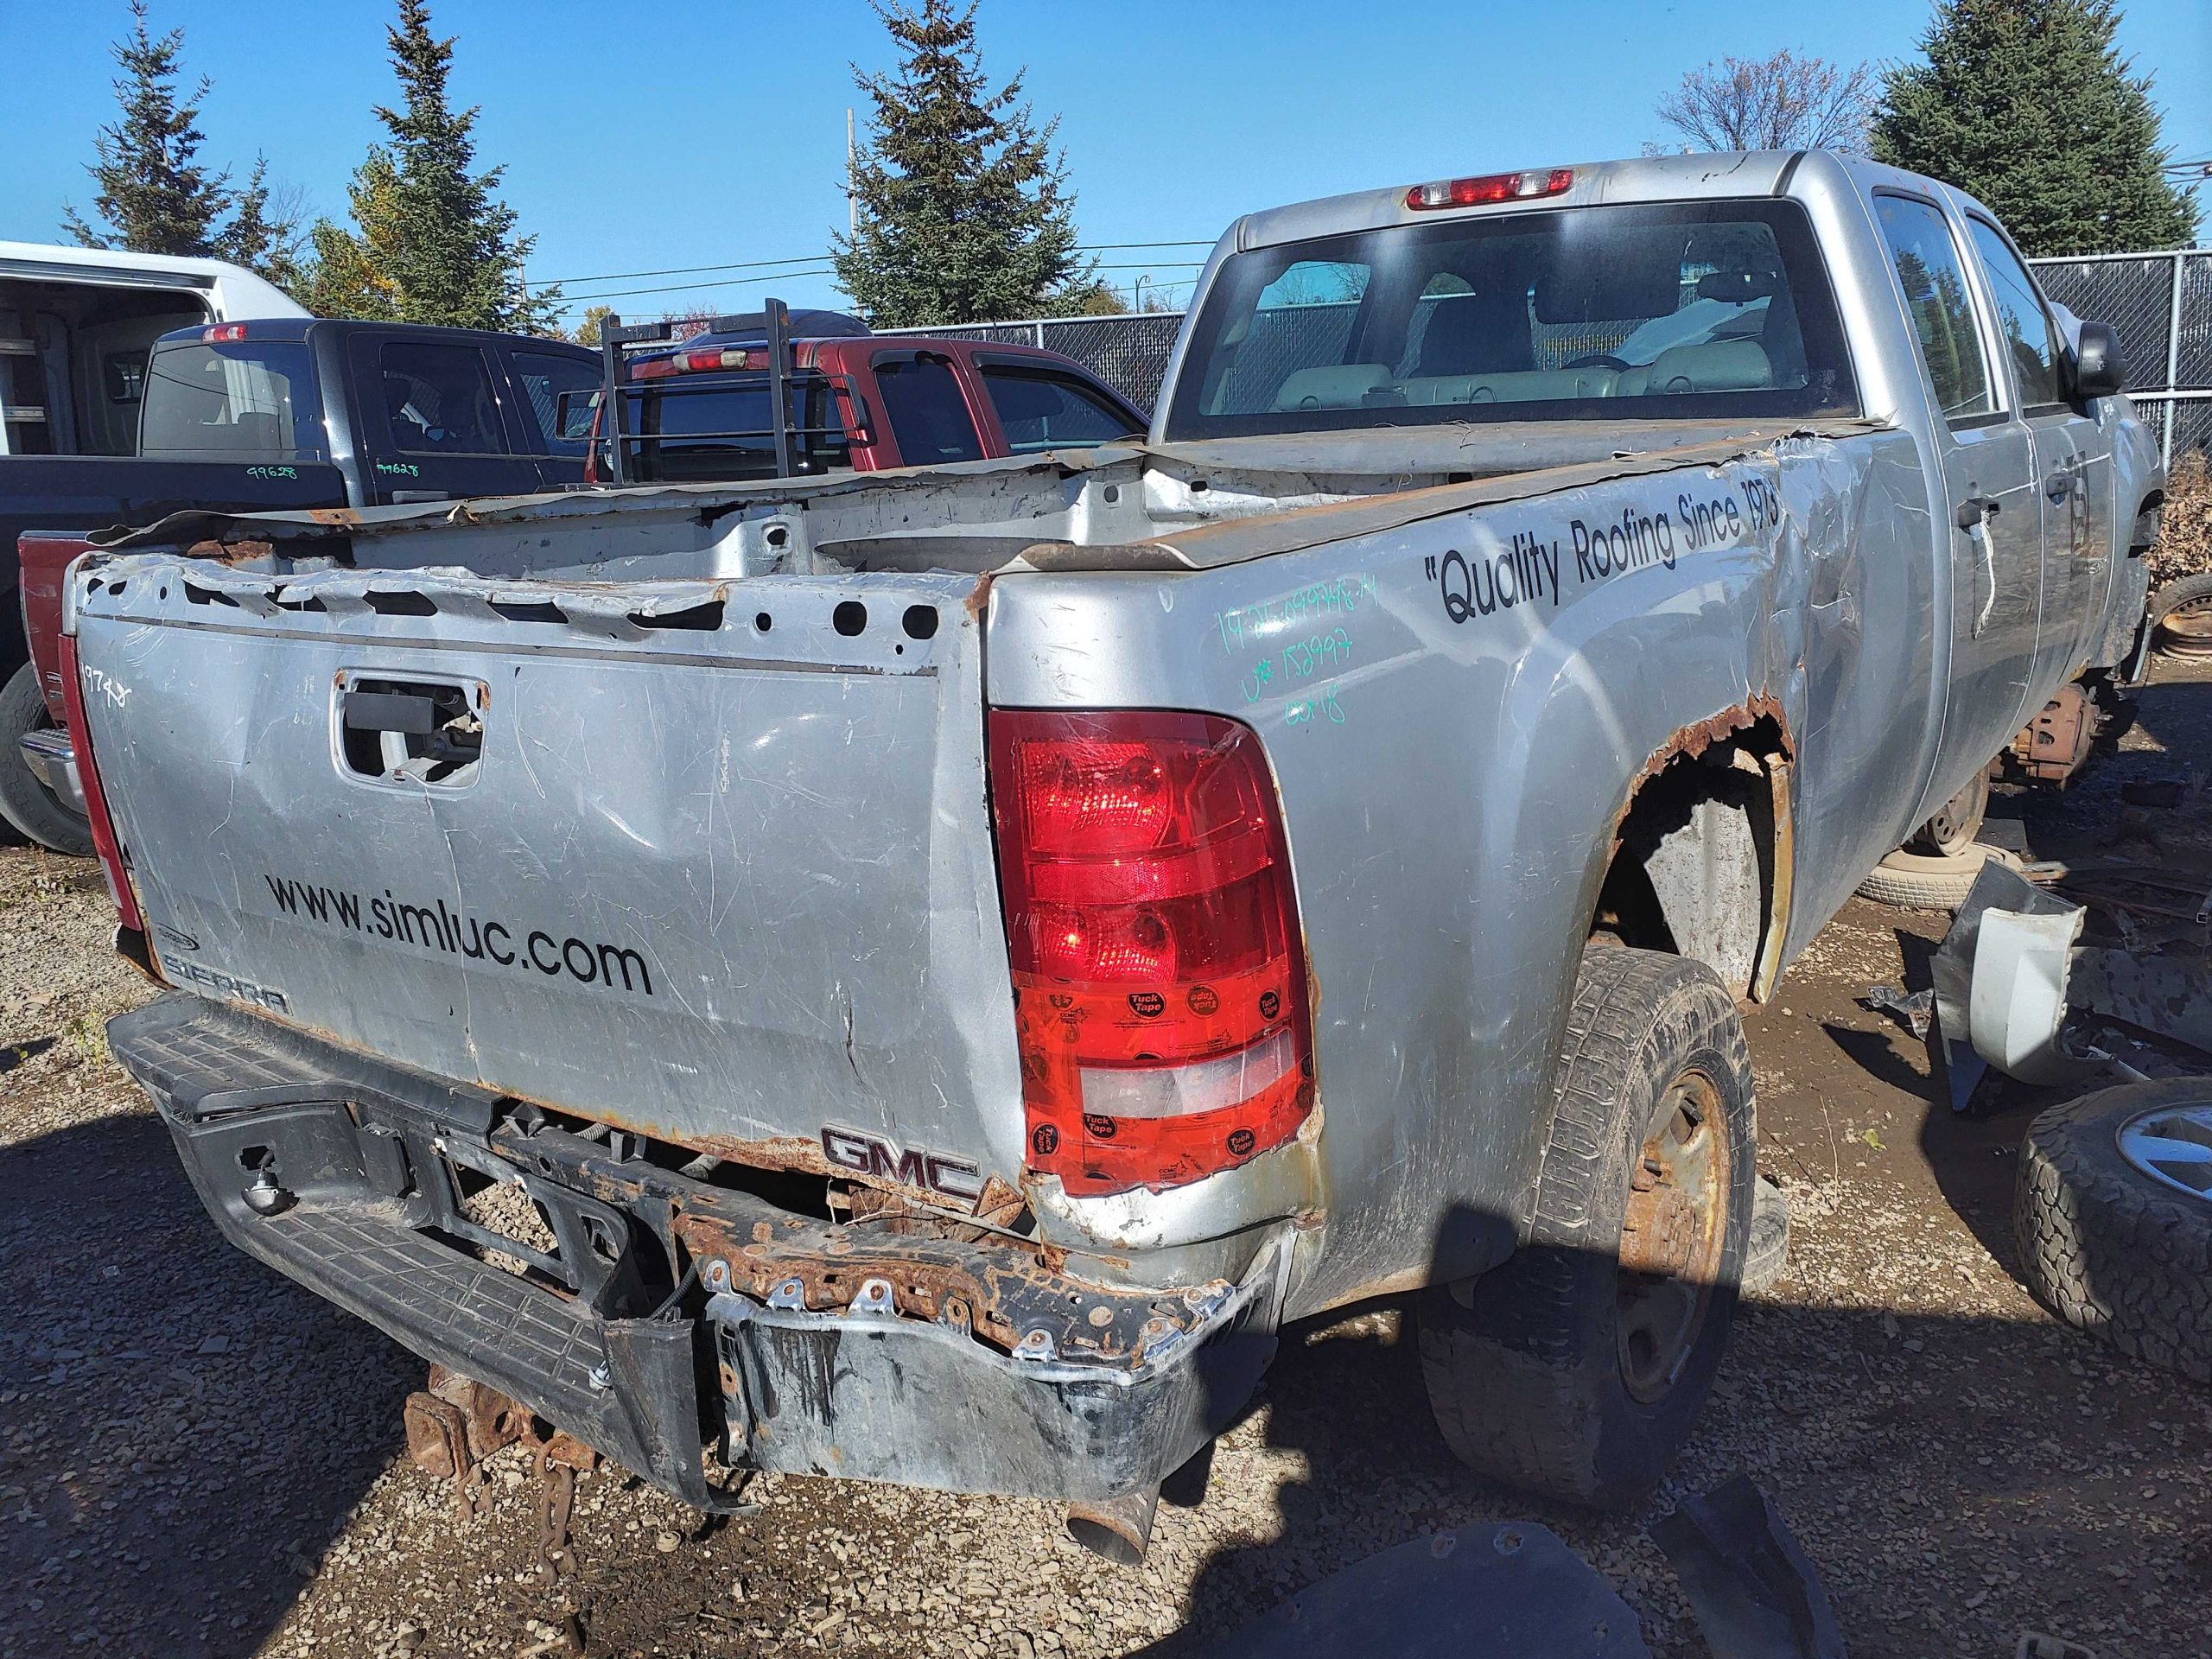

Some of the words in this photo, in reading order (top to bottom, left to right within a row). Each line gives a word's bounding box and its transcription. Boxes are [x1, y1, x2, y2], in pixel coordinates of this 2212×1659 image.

[246, 467, 298, 480] 99628
[376, 463, 419, 477] 99628
[1570, 508, 1677, 585] Roofing
[1678, 493, 1740, 551] Since
[264, 874, 654, 996] www.simluc.com
[162, 951, 295, 1017] SIERRA
[1131, 994, 1158, 1003] Tuck
[1135, 1002, 1162, 1013] Tape
[1085, 1115, 1109, 1125] Tuck
[1089, 1123, 1113, 1134] Tape
[1233, 1140, 1253, 1153] Tape
[821, 1122, 982, 1203] GMC
